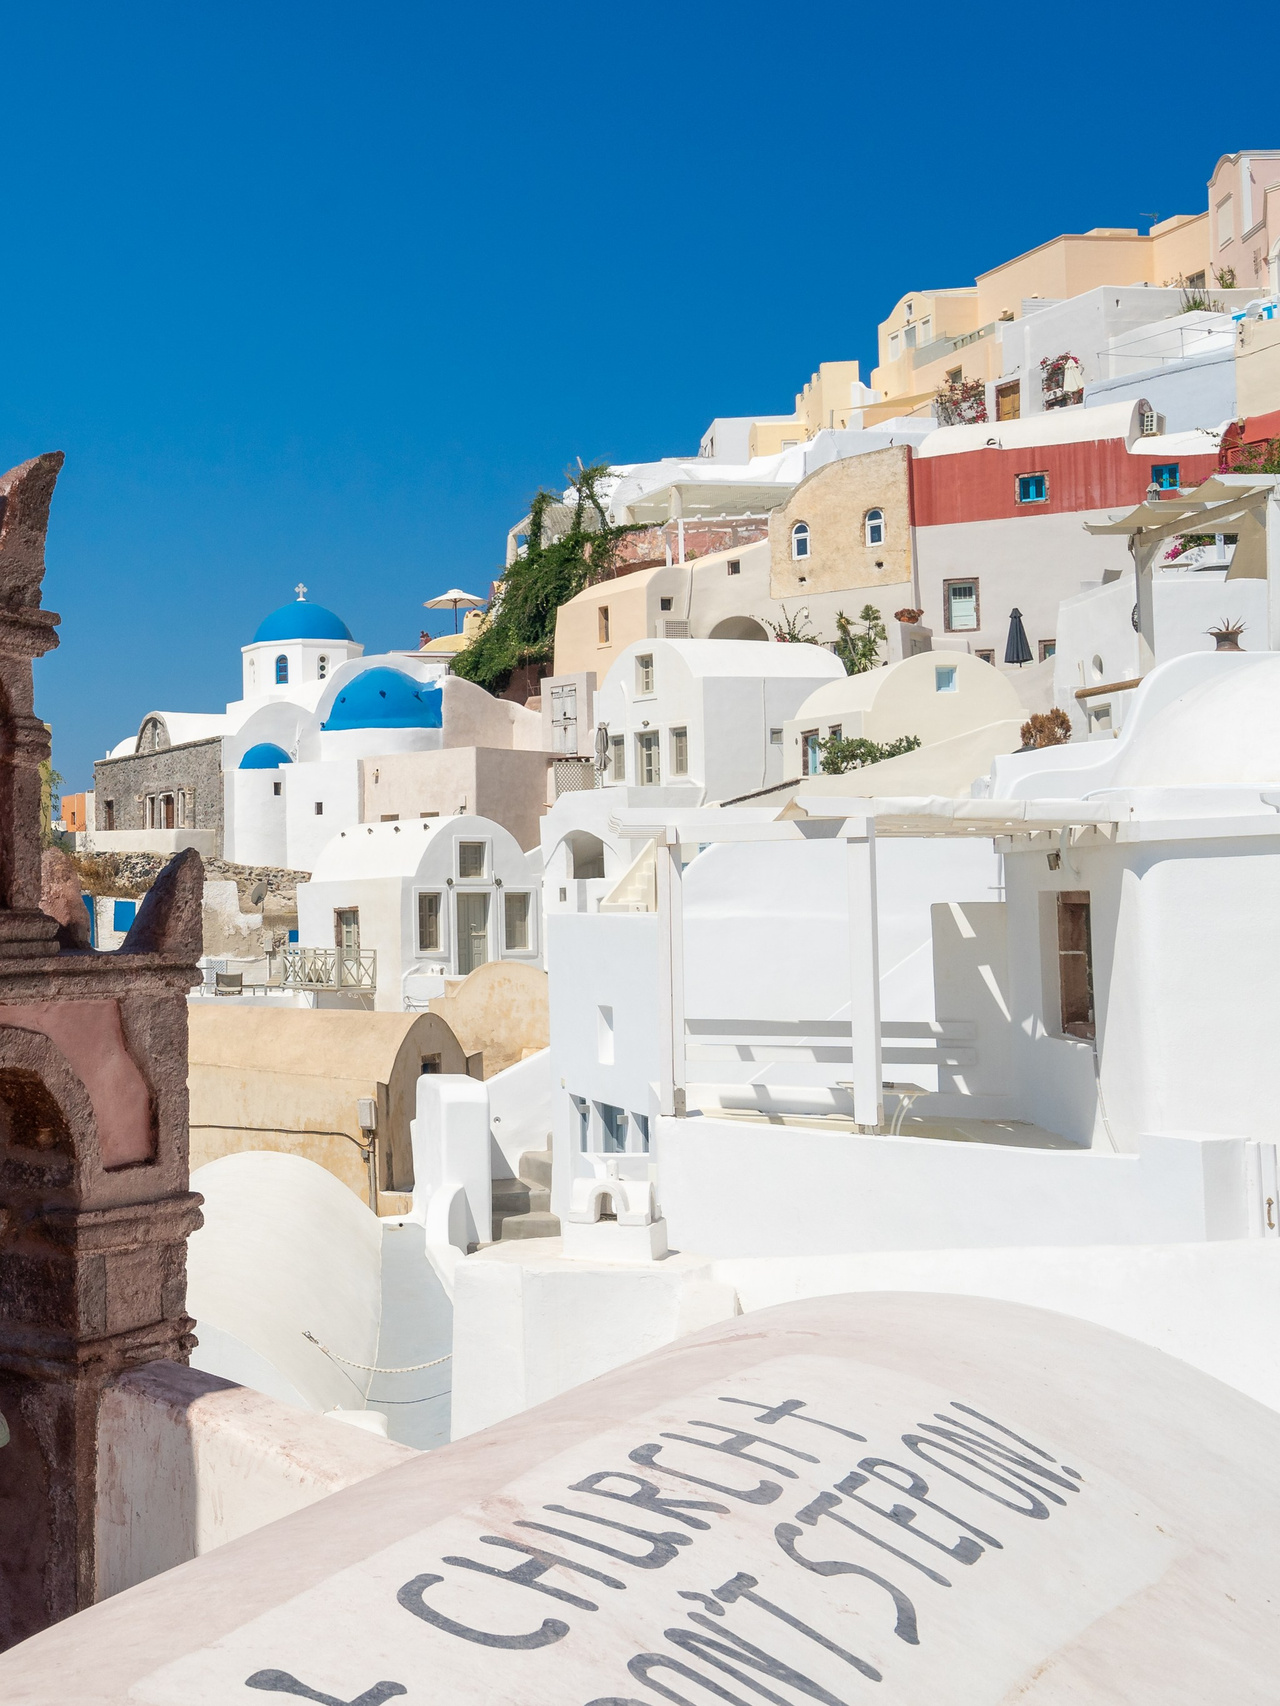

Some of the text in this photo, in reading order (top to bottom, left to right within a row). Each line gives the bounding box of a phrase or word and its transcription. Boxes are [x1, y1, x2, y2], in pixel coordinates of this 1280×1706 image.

[396, 1419, 821, 1650] CHURCH
[582, 1571, 884, 1706] N'T
[774, 1457, 1005, 1646] STEP
